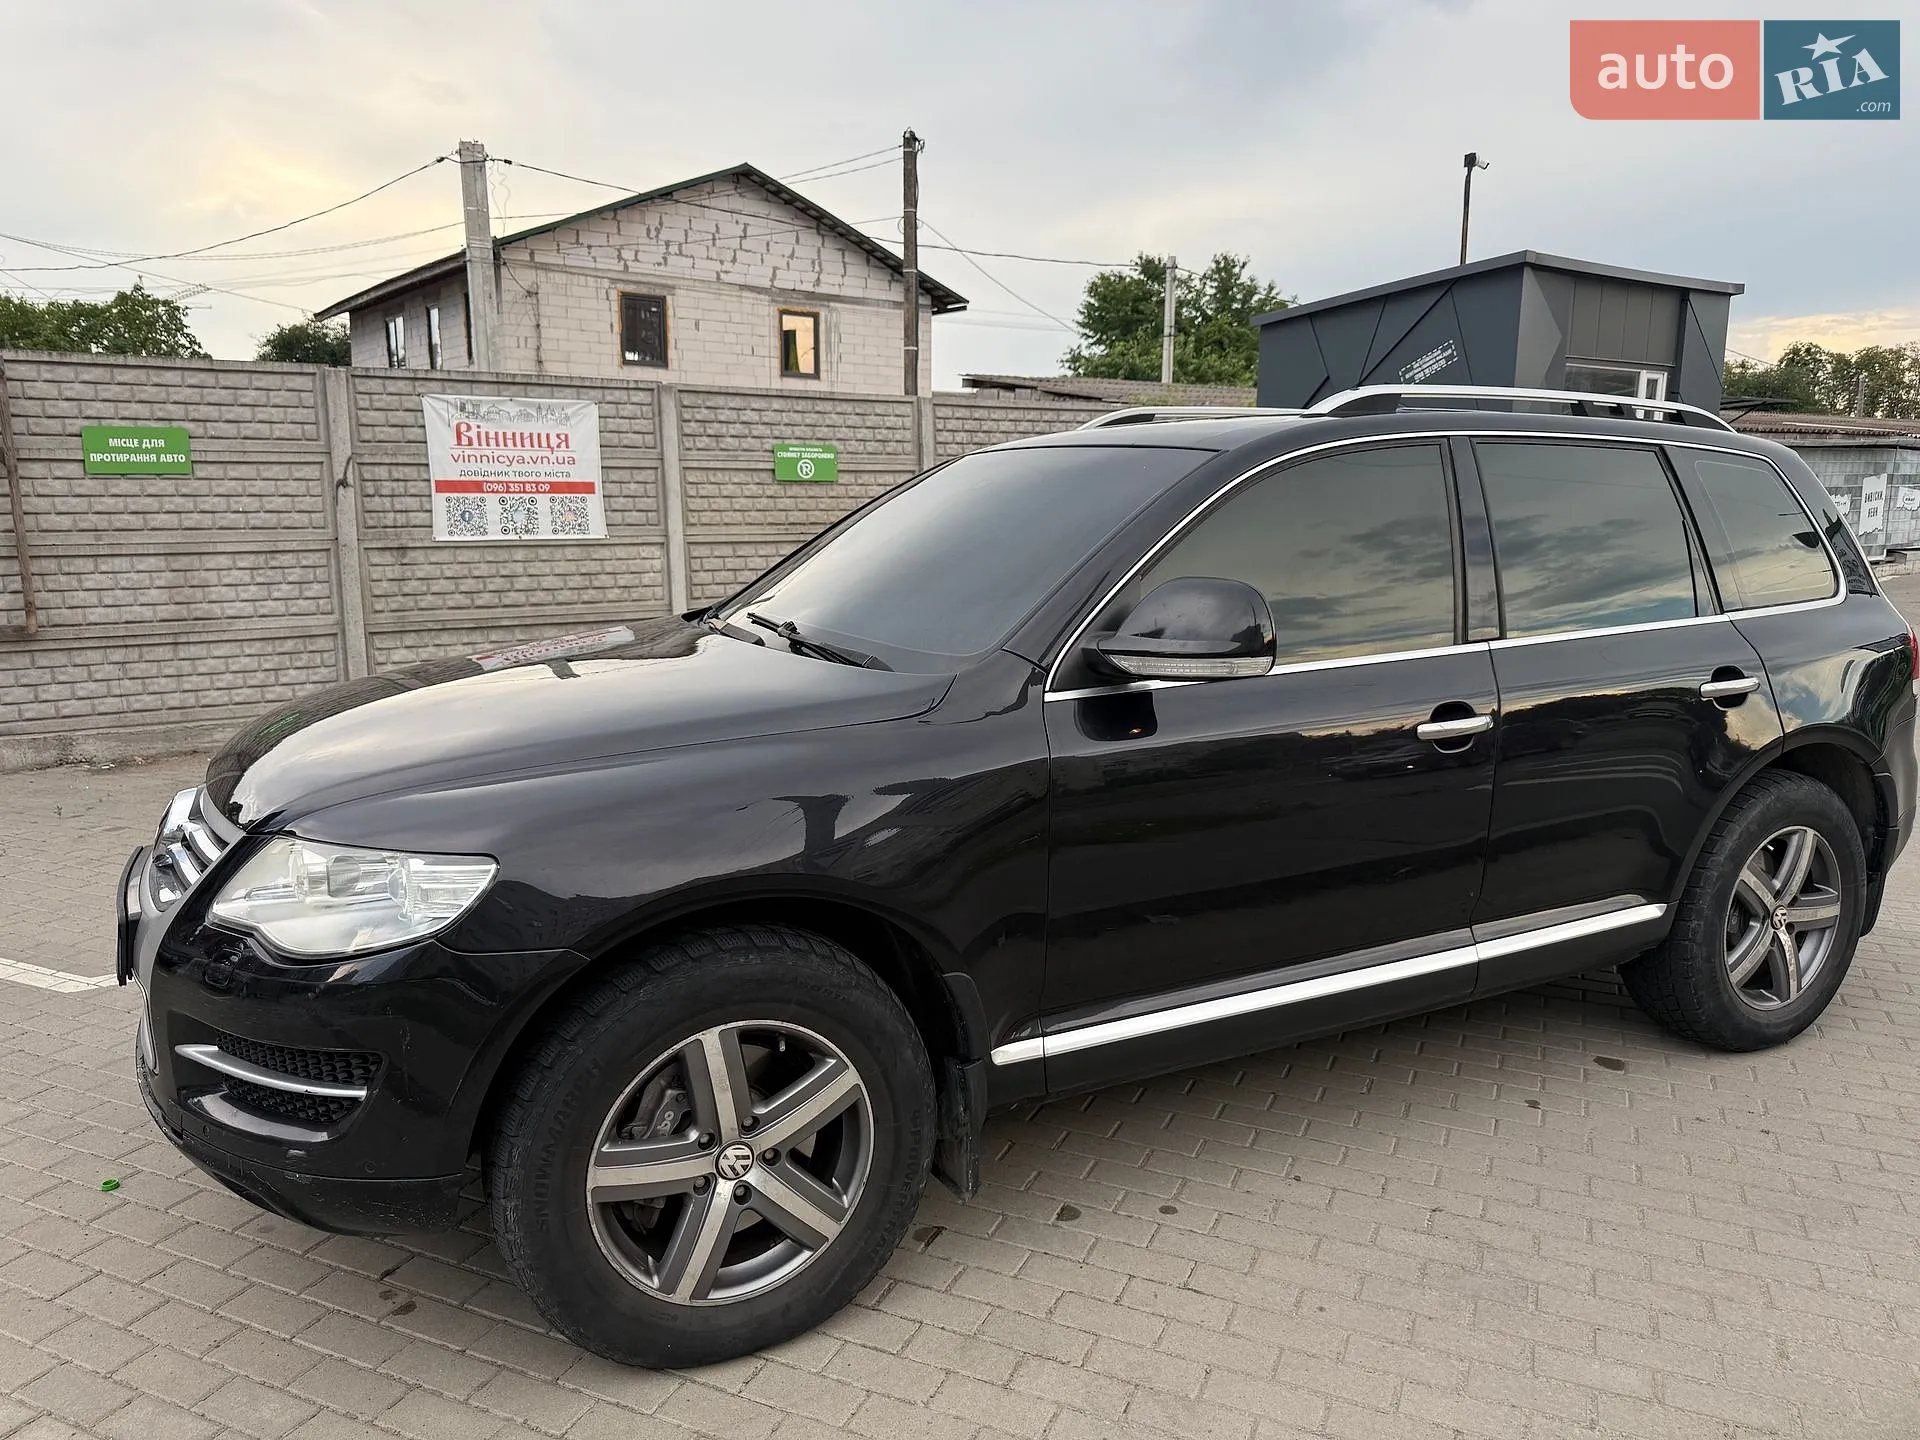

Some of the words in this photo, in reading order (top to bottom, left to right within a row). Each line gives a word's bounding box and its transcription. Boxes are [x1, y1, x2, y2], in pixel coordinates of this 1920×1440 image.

[453, 421, 570, 454] Вінниця
[108, 438, 140, 448] МІСЦЕ
[142, 439, 165, 449] ДЛЯ
[89, 453, 156, 463] ПРОТИРАННЯ
[160, 454, 186, 463] АВТО
[450, 451, 576, 467] vinnicya.vn.ua
[459, 468, 510, 479] довідник
[513, 470, 541, 478] твого
[544, 470, 571, 479] міста
[483, 483, 507, 493] (096)
[508, 483, 524, 493] 351
[525, 483, 537, 493] 83
[538, 484, 551, 493] 09
